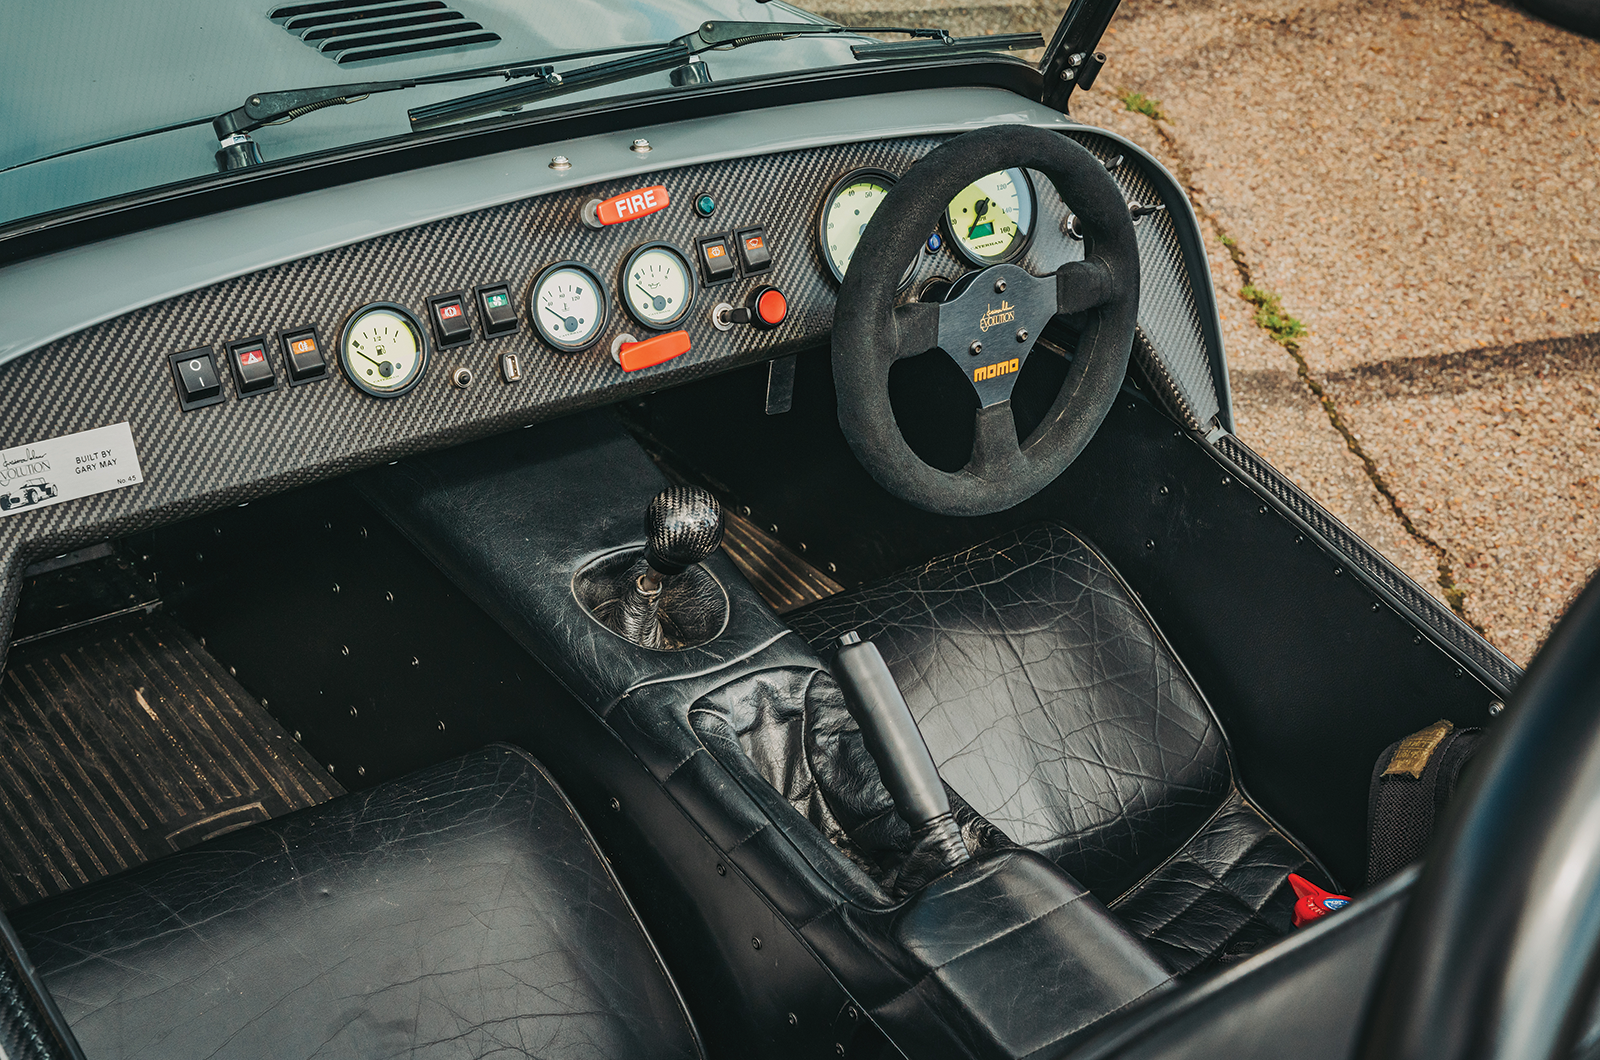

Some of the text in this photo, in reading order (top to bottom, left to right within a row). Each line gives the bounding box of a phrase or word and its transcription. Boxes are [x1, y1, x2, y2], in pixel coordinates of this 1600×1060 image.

[996, 183, 1007, 191] 120
[615, 189, 658, 218] FIRE
[1000, 226, 1011, 234] 160
[830, 244, 838, 252] 10
[980, 311, 1015, 333] EVOLUTION
[75, 449, 112, 465] BUILT BY
[0, 460, 51, 483] VOLUTION
[75, 458, 118, 475] GARY MAY
